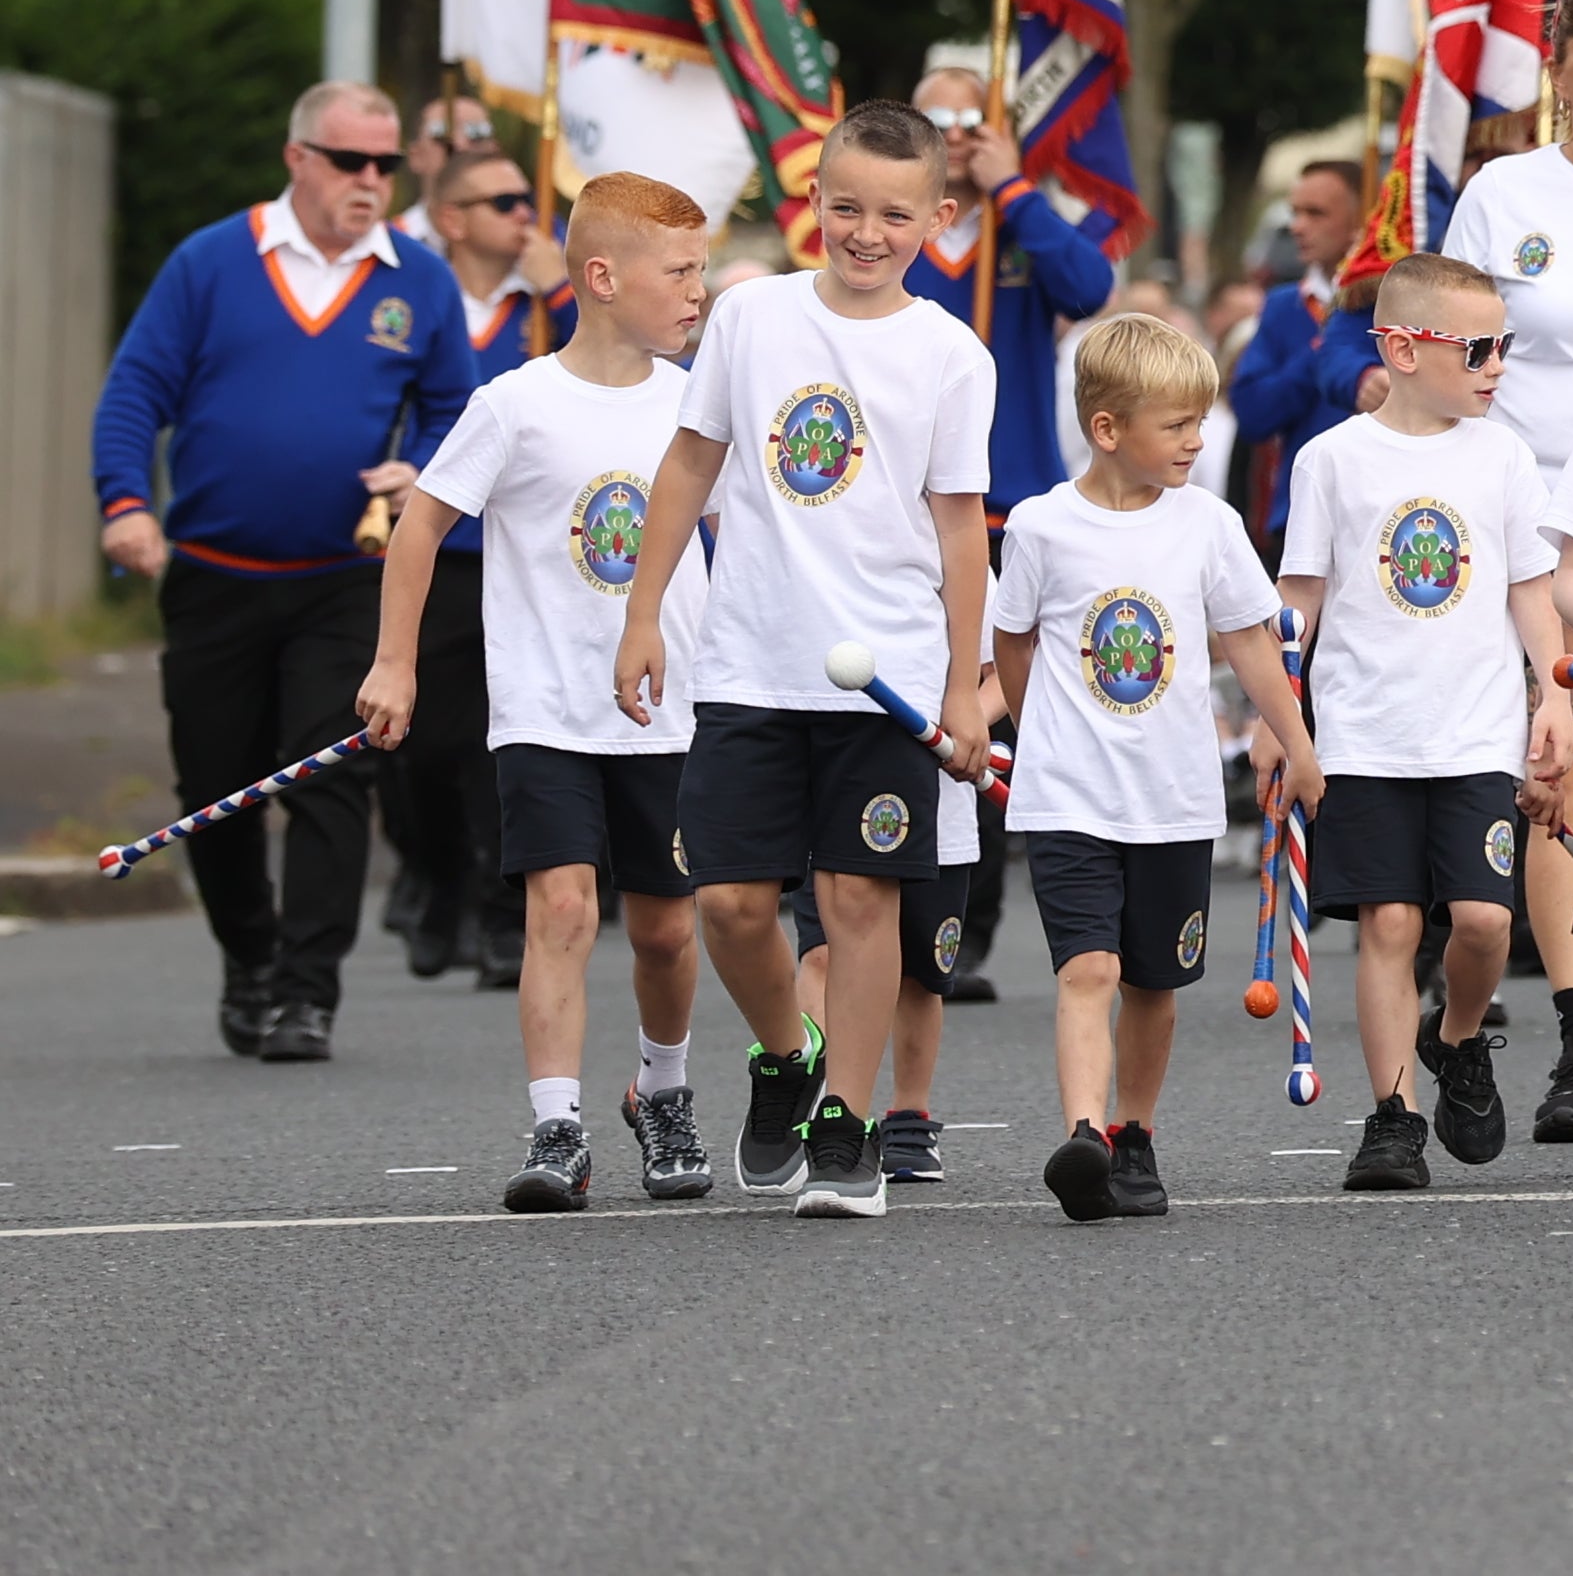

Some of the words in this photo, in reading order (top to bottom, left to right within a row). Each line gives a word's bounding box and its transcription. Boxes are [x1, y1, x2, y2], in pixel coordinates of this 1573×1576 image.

[774, 393, 801, 425] PRIDE
[806, 383, 822, 395] OF
[830, 387, 866, 437] ARDOYNE
[811, 427, 825, 441] O
[796, 442, 808, 456] P
[821, 447, 833, 461] A
[572, 483, 597, 518] PRIDE
[599, 471, 616, 484] OF
[768, 465, 799, 503] NORTH
[803, 477, 850, 507] BELFAST
[612, 515, 625, 529] O
[1380, 511, 1403, 546] PRIDE
[1405, 498, 1421, 511] OF
[1429, 499, 1470, 545] ARDOYNE
[601, 532, 611, 547] P
[624, 535, 635, 548] A
[1419, 541, 1432, 555] O
[1408, 558, 1419, 572] P
[1432, 558, 1444, 572] A
[576, 558, 608, 593] NORTH
[1385, 585, 1419, 618] NORTH
[1424, 586, 1465, 619] BELFAST
[1081, 602, 1101, 639] PRIDE
[1104, 588, 1120, 603] OF
[1129, 588, 1173, 634] ARDOYNE
[1120, 632, 1134, 646] O
[1109, 651, 1121, 666] P
[1135, 650, 1147, 665] A
[1087, 680, 1123, 715] NORTH
[1128, 677, 1169, 716] BELFAST
[822, 1105, 843, 1120] 23
